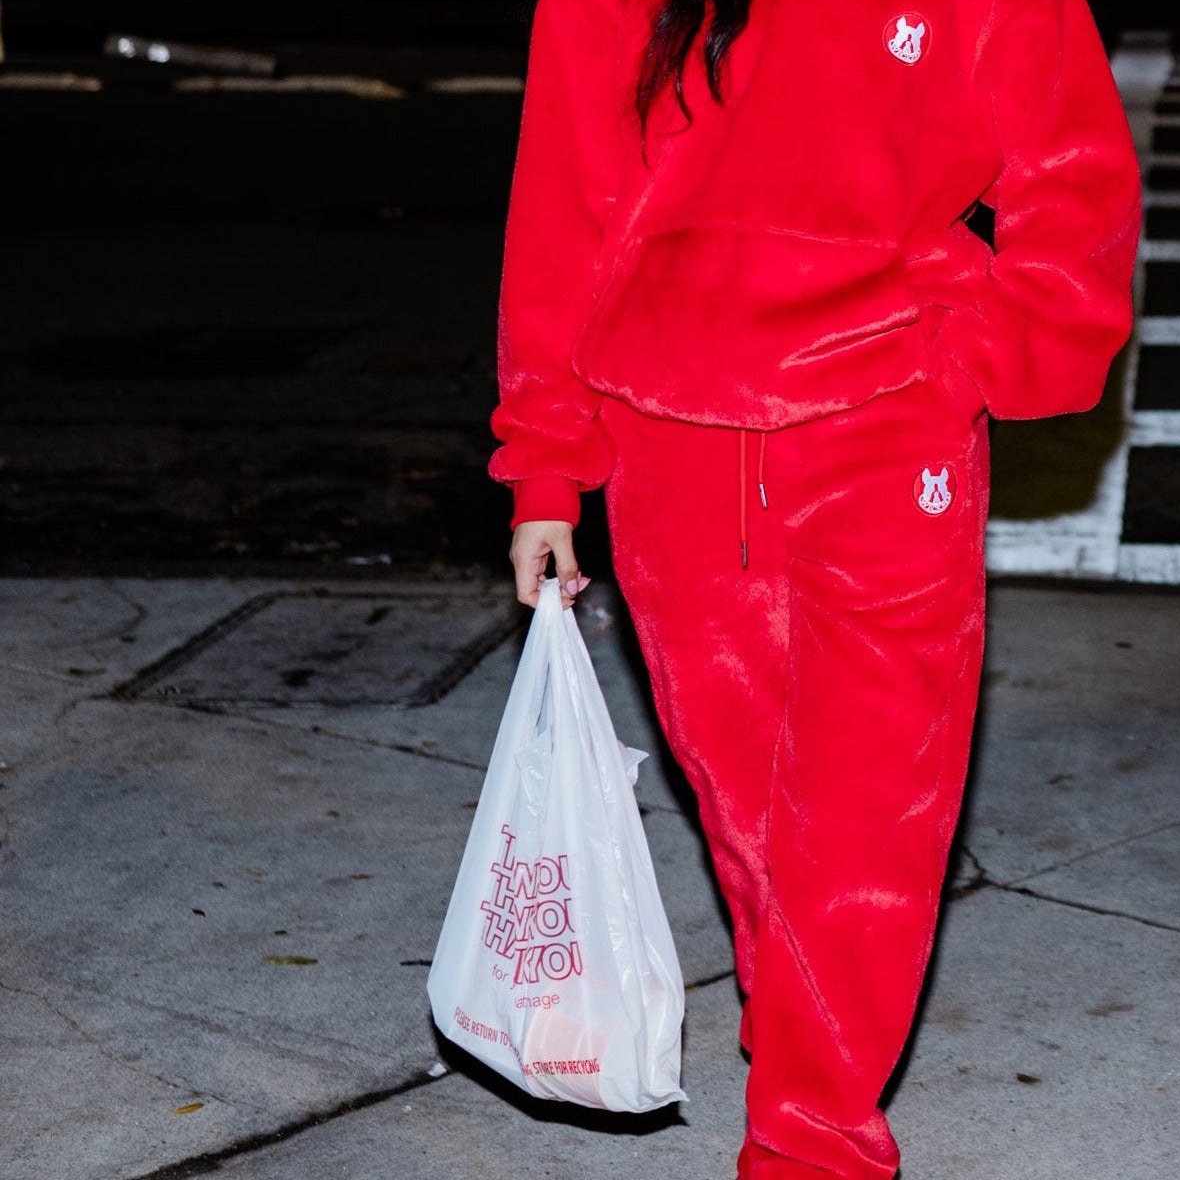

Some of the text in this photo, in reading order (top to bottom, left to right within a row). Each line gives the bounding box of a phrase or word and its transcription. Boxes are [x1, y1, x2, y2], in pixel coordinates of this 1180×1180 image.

[491, 964, 510, 982] for
[471, 1021, 498, 1043] RETURN
[500, 1031, 509, 1046] TO
